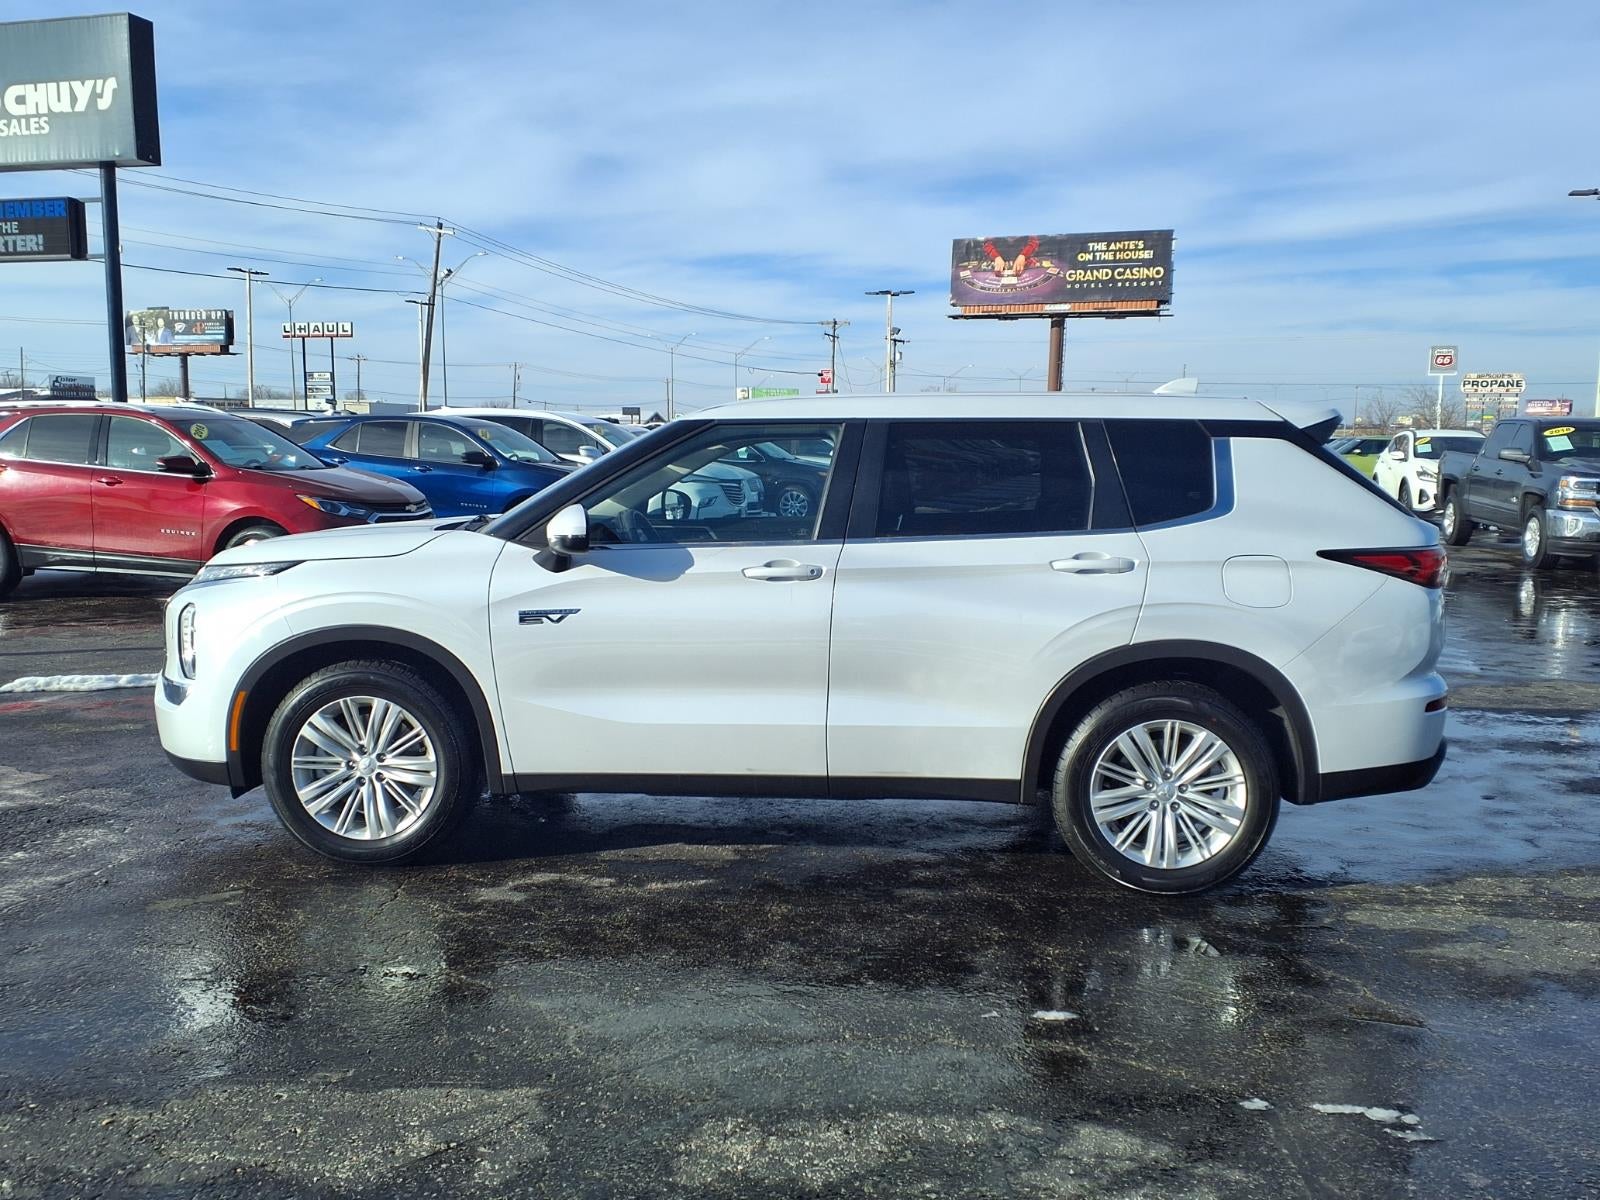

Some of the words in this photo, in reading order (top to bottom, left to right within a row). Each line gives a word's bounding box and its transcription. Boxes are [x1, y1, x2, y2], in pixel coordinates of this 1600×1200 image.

[4, 76, 118, 117] CHUY'S
[0, 117, 50, 137] SALES
[0, 200, 66, 219] EMBER
[1088, 242, 1108, 251] THE
[1109, 240, 1145, 250] ANTE'S
[1077, 252, 1094, 261] ON
[1095, 251, 1111, 261] THE
[1116, 250, 1154, 260] HOUSE!
[1065, 269, 1113, 281] GRAND
[1114, 266, 1165, 280] CASINO
[168, 311, 207, 320] THUNDER
[211, 310, 226, 320] UP!
[1436, 355, 1452, 365] 66
[1463, 380, 1523, 388] PROPANE
